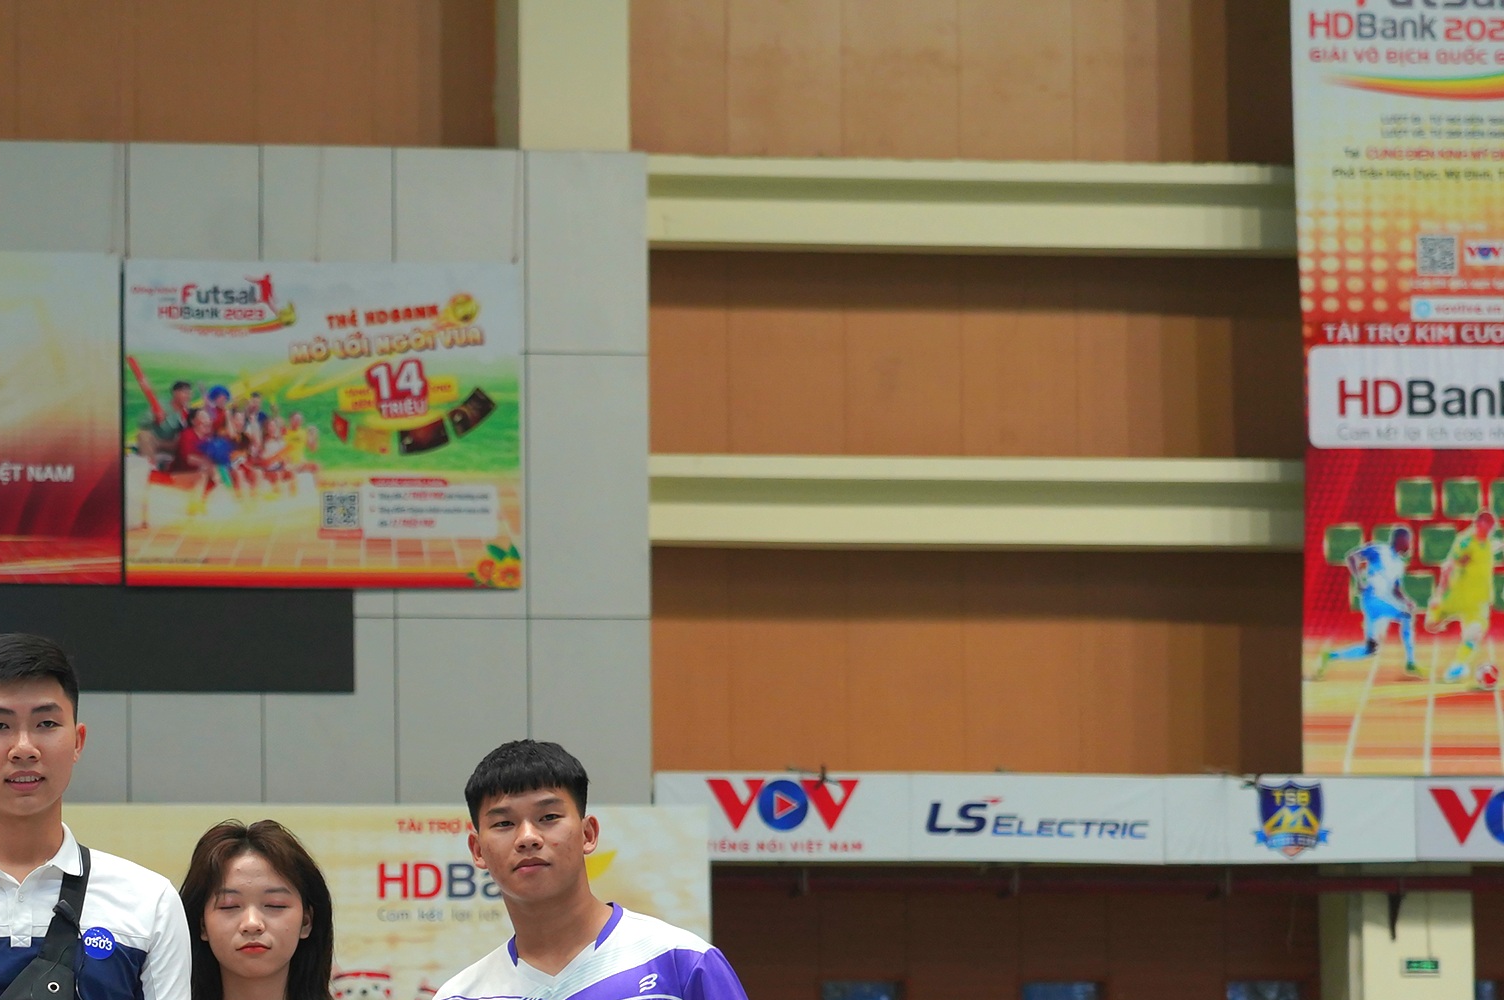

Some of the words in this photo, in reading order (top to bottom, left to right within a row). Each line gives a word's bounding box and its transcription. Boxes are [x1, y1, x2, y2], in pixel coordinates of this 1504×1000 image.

[1308, 11, 1436, 40] HDBank
[1308, 46, 1348, 64] GIẢI
[181, 283, 257, 305] Futsal
[157, 306, 220, 320] HDBank
[224, 308, 267, 321] 2023
[363, 305, 439, 326] HDBANK
[438, 326, 485, 349] VUA
[1322, 321, 1360, 343] TÀI
[1364, 322, 1411, 346] TRỢ
[1415, 324, 1456, 343] KIM
[370, 360, 424, 400] 14
[1337, 377, 1504, 417] HDBan
[26, 463, 74, 483] NAM
[705, 778, 859, 831] VOV
[395, 816, 424, 834] TÀI
[428, 818, 463, 836] TRỢ
[924, 800, 989, 836] LS
[990, 813, 1150, 841] ELECTRIC
